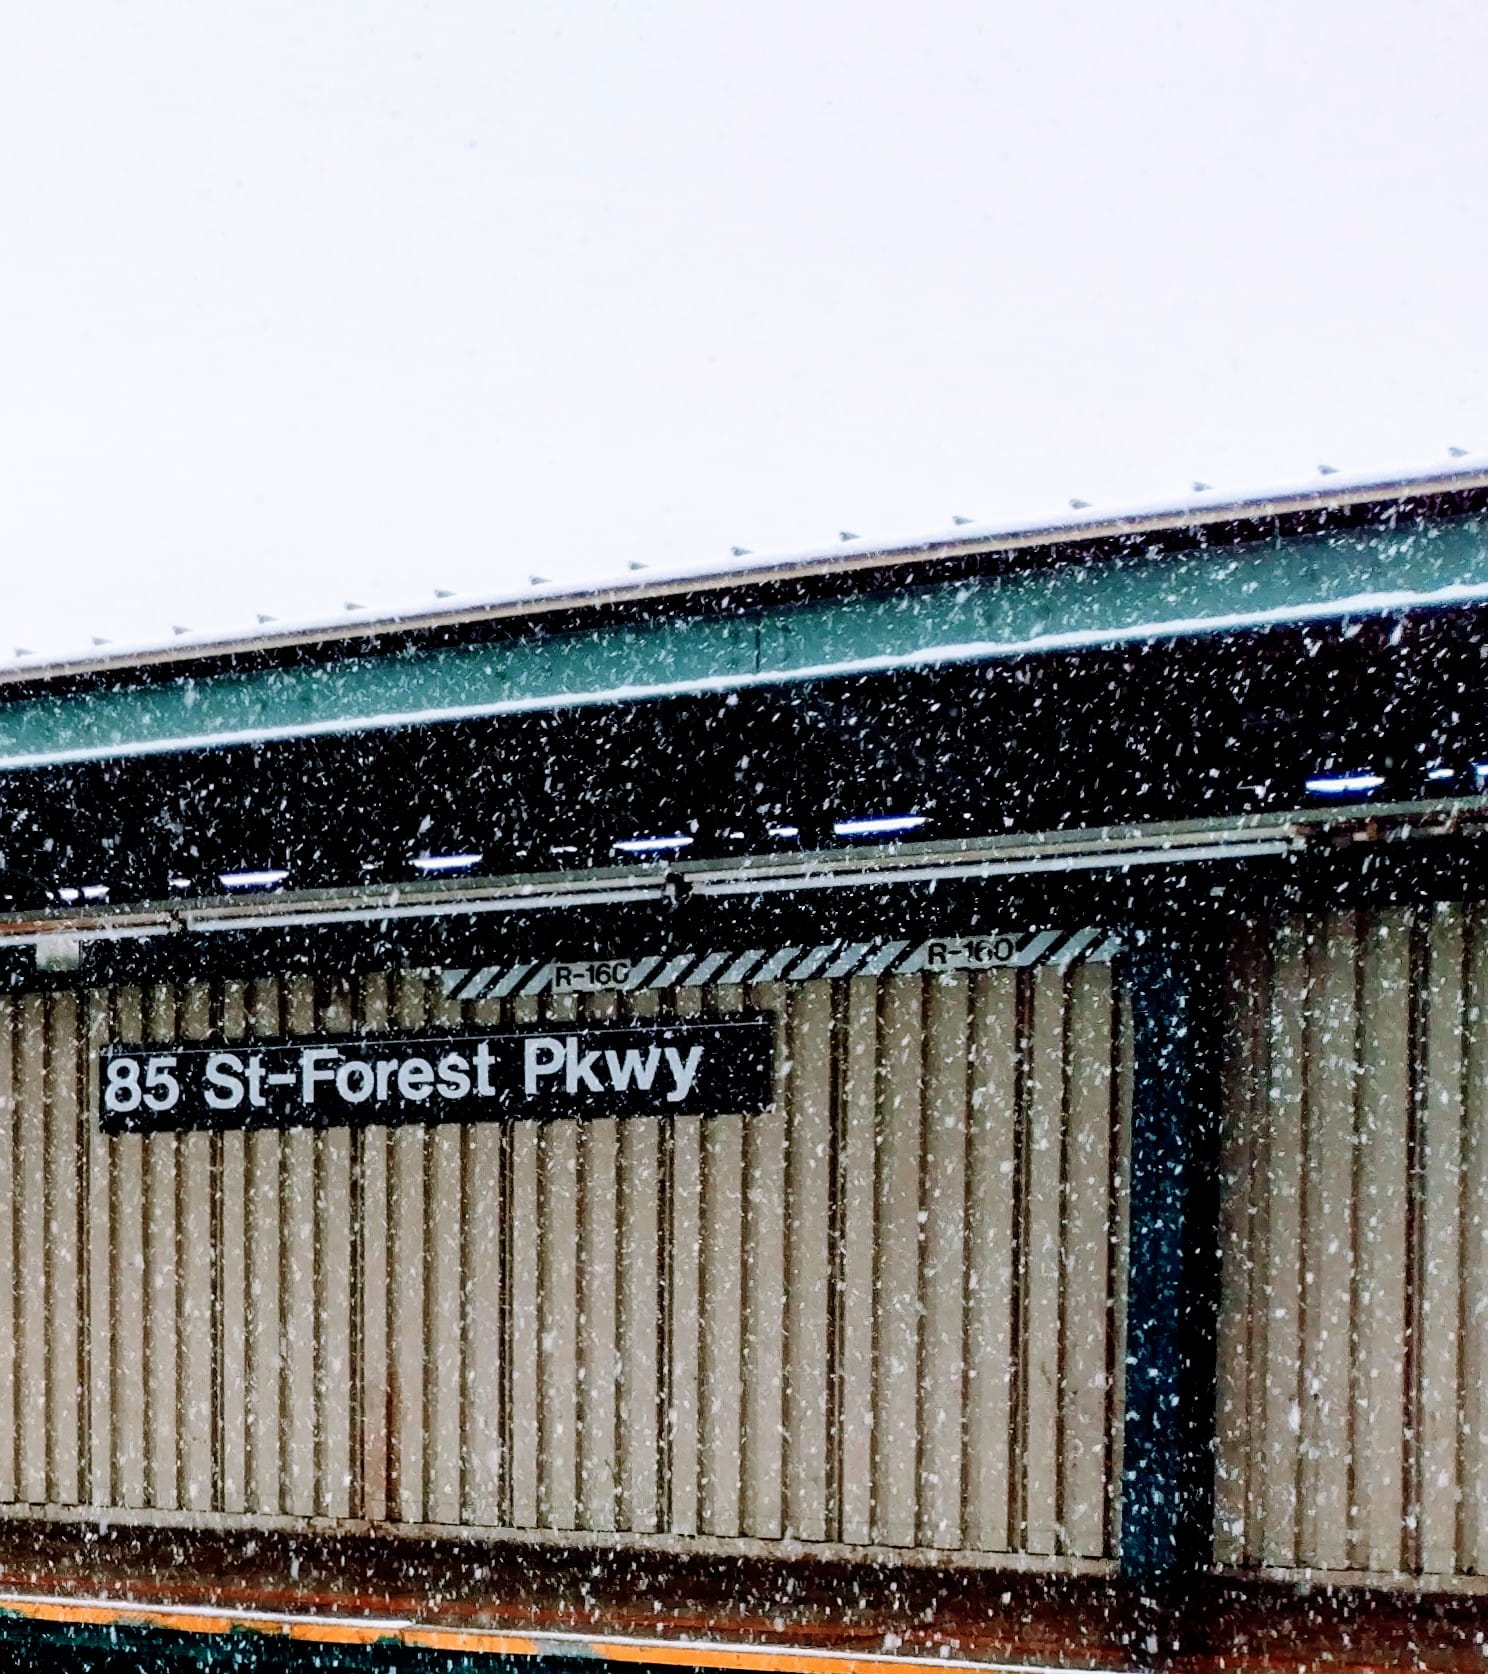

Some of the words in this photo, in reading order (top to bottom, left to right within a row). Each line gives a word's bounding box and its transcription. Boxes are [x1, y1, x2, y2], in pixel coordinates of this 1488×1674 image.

[926, 938, 1013, 965] R-160
[106, 1056, 180, 1112] 85
[204, 1041, 496, 1110] St-Forest
[524, 1035, 703, 1102] Pkwy
